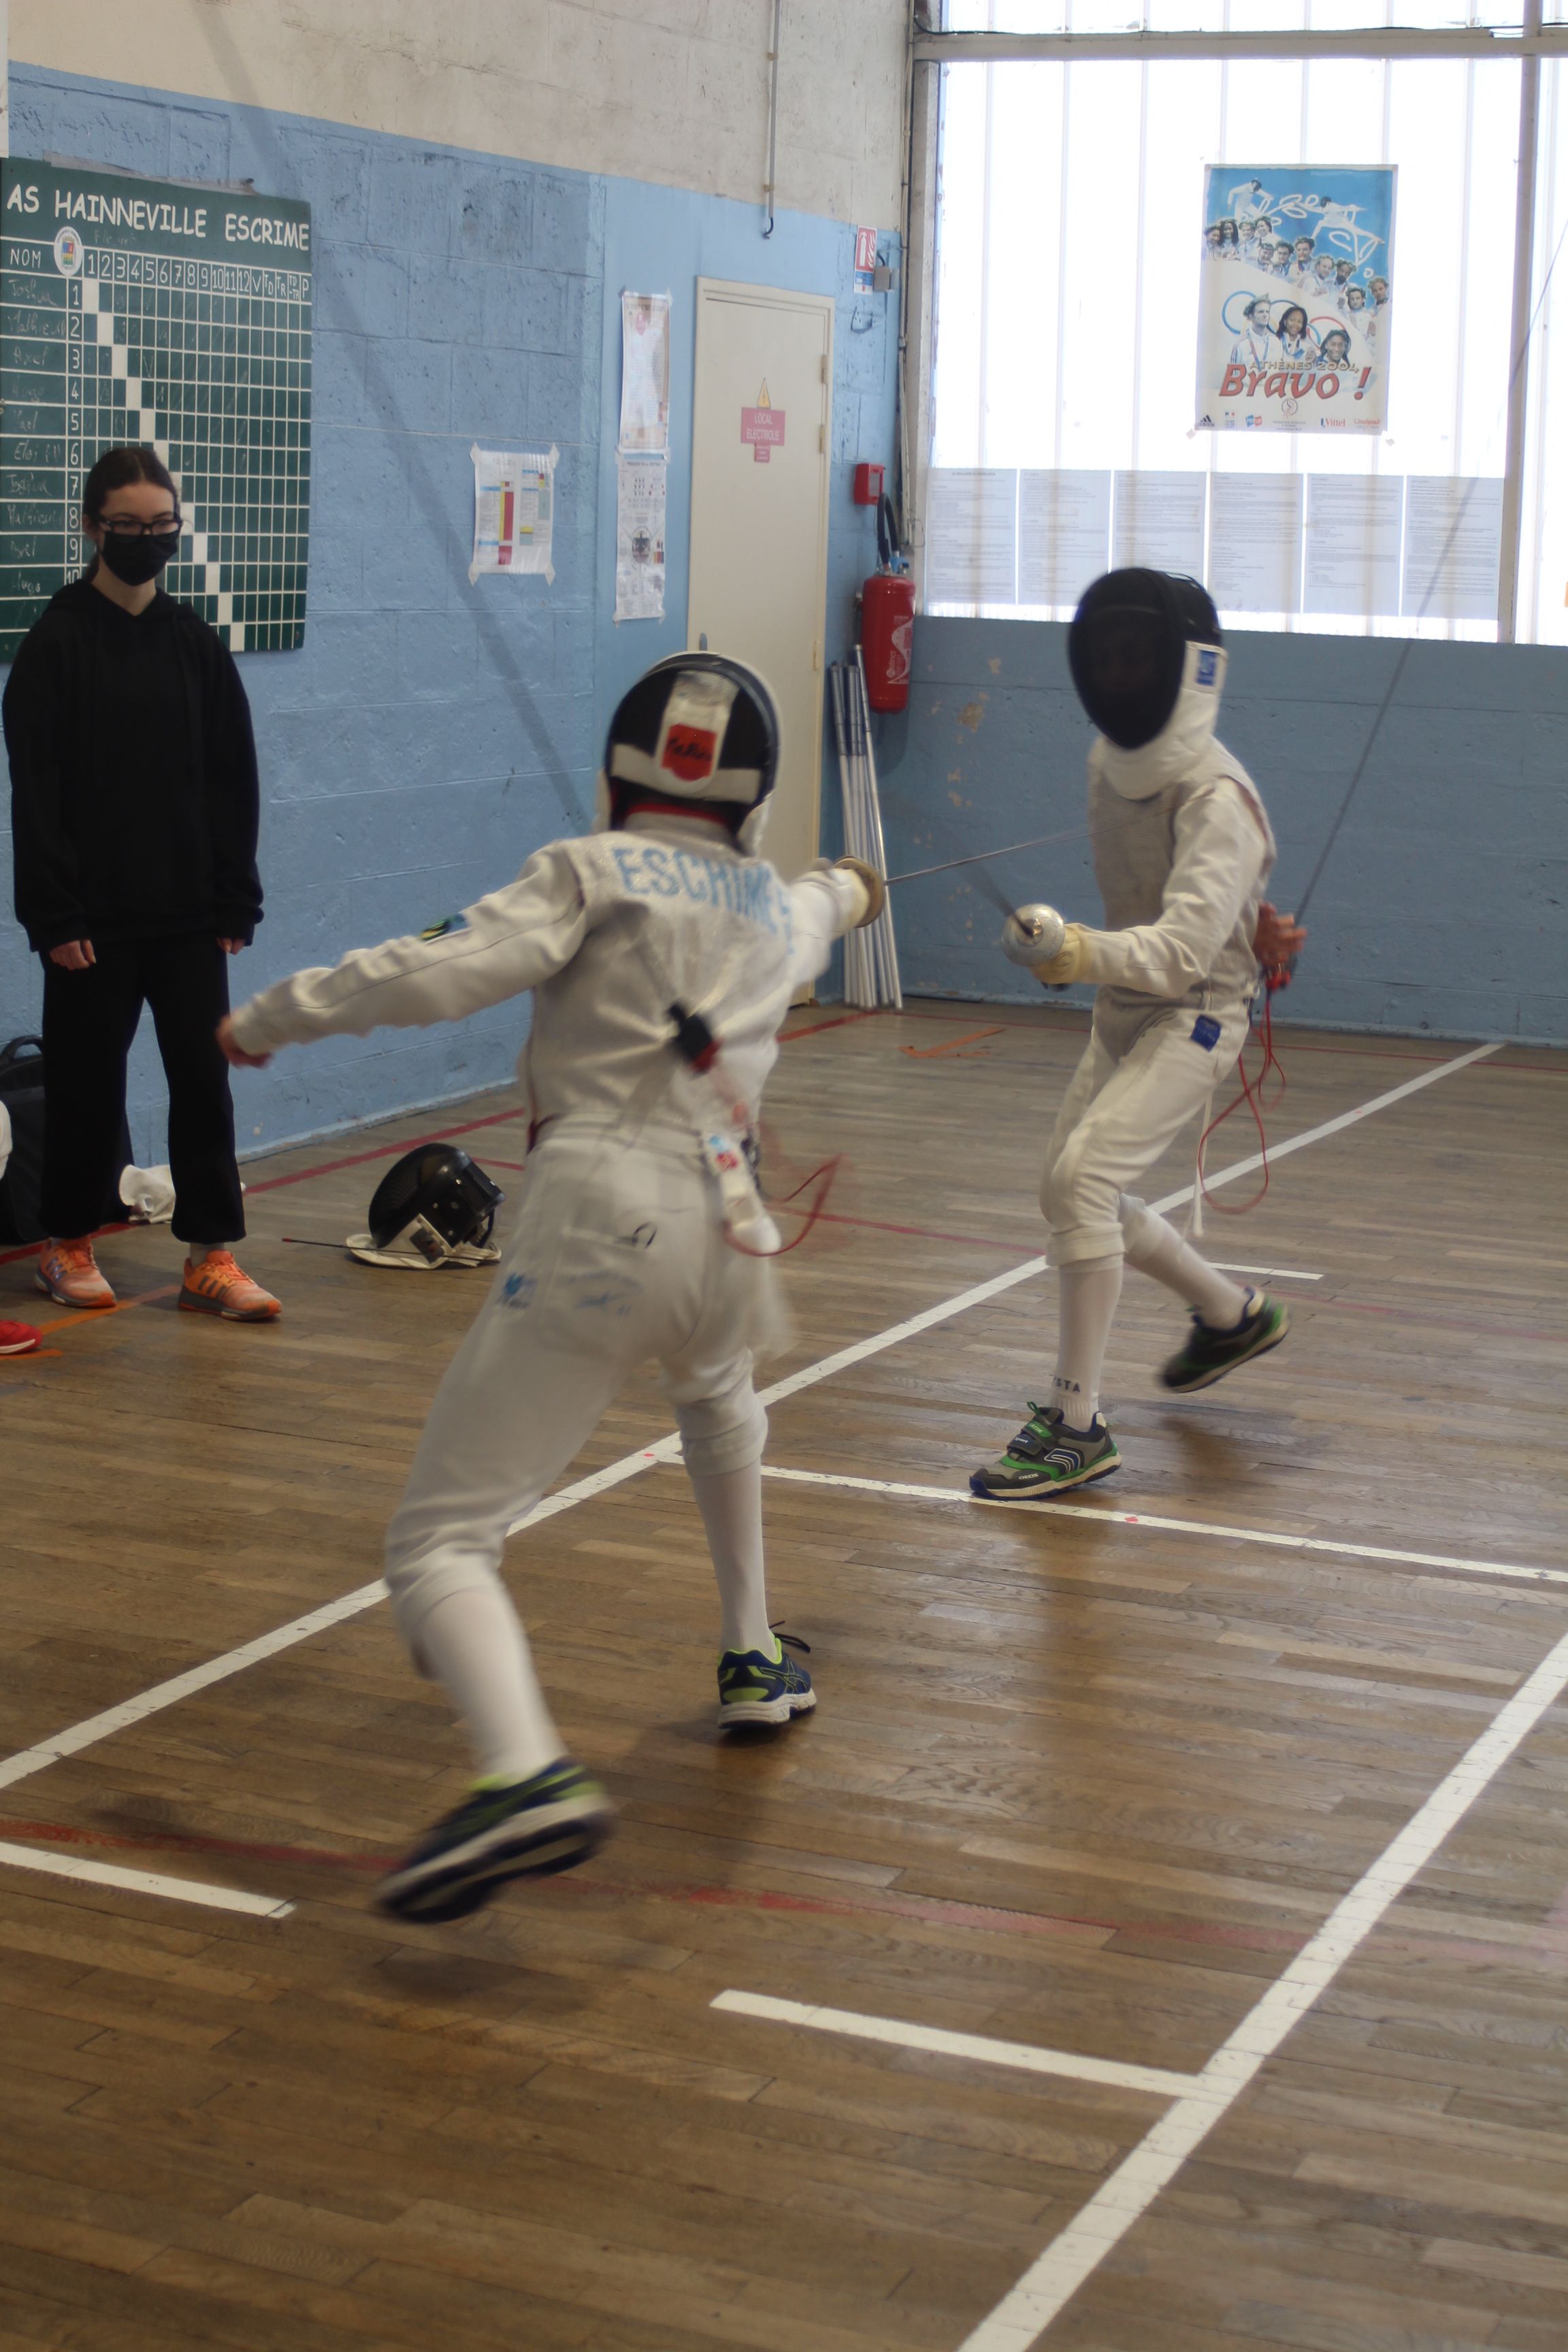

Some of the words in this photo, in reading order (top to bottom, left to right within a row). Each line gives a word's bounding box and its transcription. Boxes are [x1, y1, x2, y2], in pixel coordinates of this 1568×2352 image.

[7, 184, 39, 213] AS
[54, 189, 207, 238] HAINNEVILLE
[225, 213, 309, 250] ESCRIME
[10, 248, 42, 268] NOM
[88, 254, 95, 275] 1
[101, 255, 111, 276] 2
[116, 257, 126, 278] 3
[131, 259, 140, 280] 4
[145, 261, 154, 280] 5
[159, 261, 168, 283] 6
[174, 265, 182, 284] 7
[187, 264, 195, 286] 8
[201, 267, 208, 287] 9
[212, 268, 224, 289] 10
[225, 271, 236, 291] 11
[239, 270, 250, 292] 12
[252, 276, 261, 293] V
[302, 278, 309, 299] P
[73, 284, 80, 305] 1
[70, 316, 80, 338] 2
[73, 348, 80, 369] 3
[1317, 361, 1360, 374] 2004
[71, 381, 79, 399] 4
[1218, 363, 1340, 400] Bravo
[1354, 366, 1372, 400] !
[71, 413, 79, 431] 5
[754, 412, 772, 425] LOCAL
[1326, 419, 1346, 427] Vittel
[70, 443, 78, 466] 6
[70, 476, 78, 496] 7
[69, 507, 78, 529] 8
[69, 538, 78, 560] 9
[1054, 1377, 1081, 1392] STA
